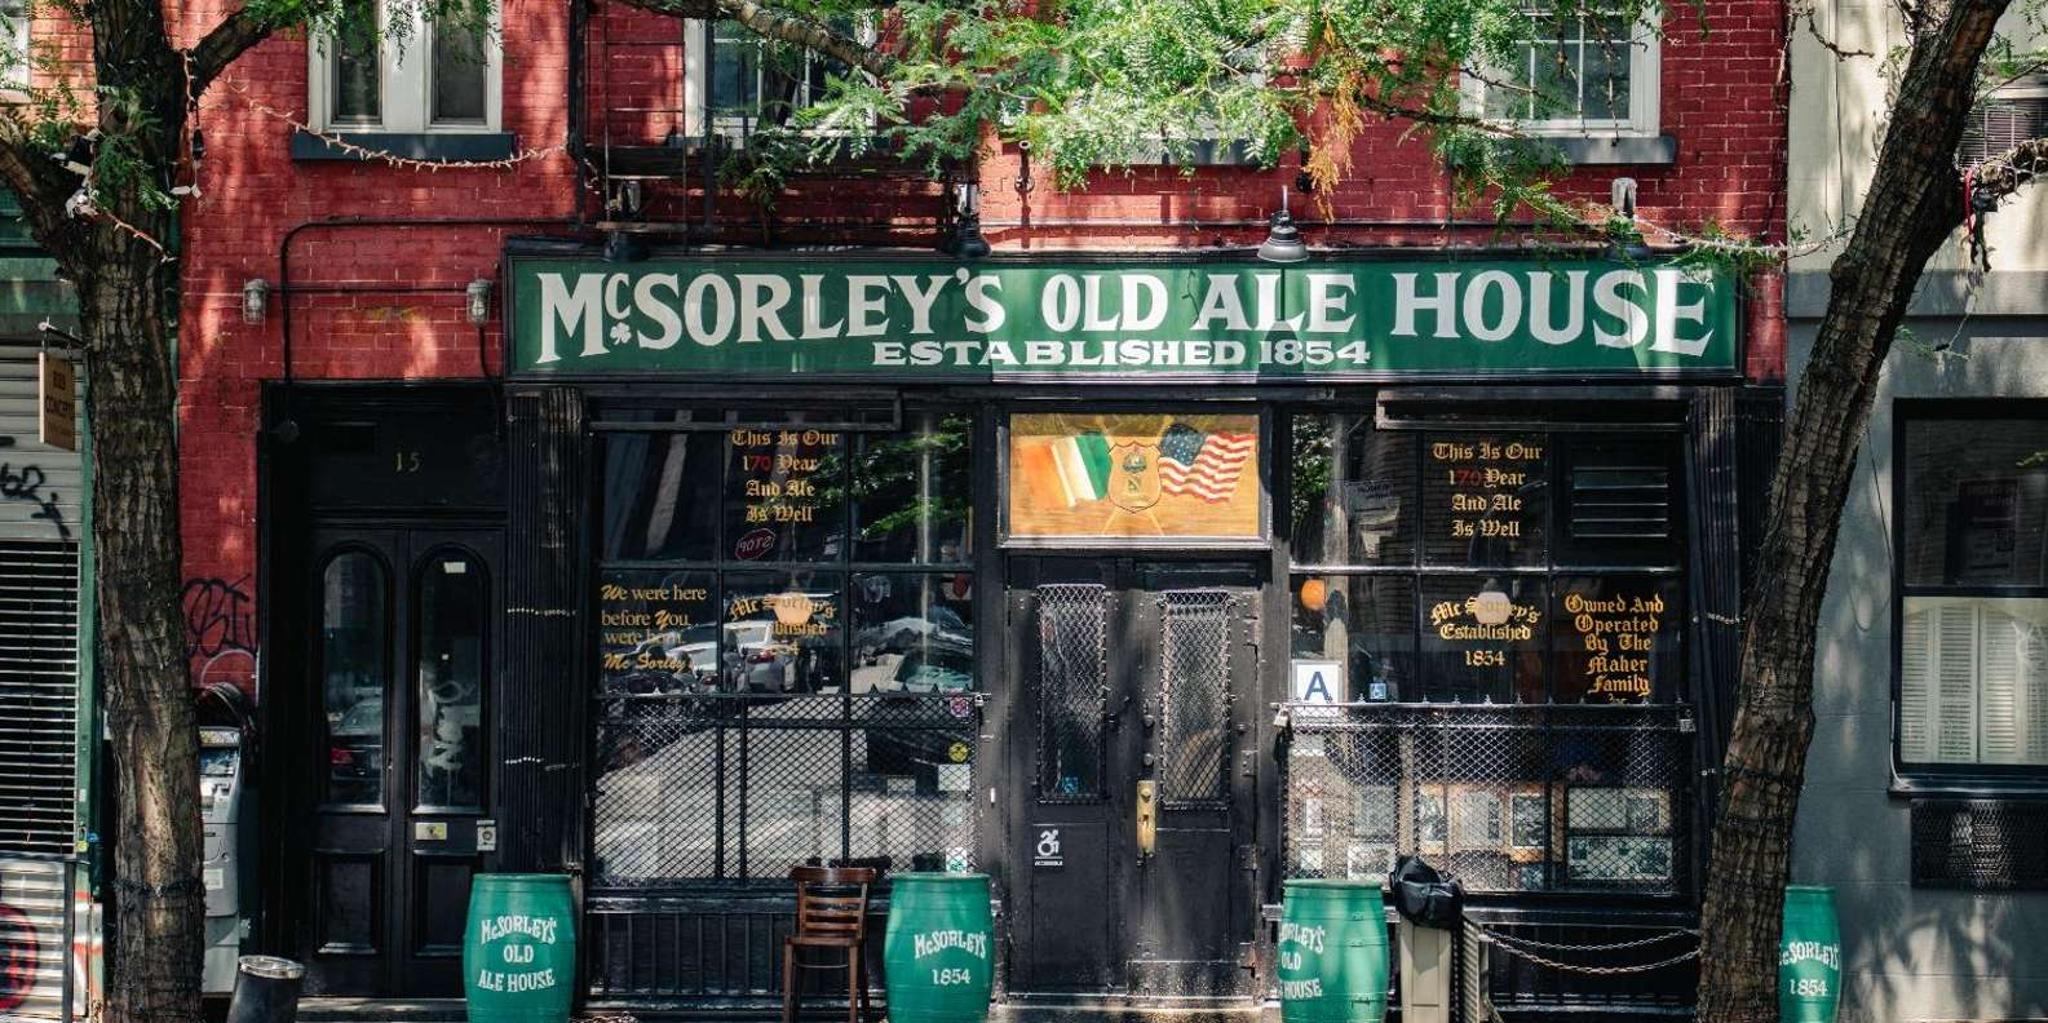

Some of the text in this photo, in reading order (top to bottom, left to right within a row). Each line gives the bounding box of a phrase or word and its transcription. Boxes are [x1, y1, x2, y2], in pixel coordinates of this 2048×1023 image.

[1042, 274, 1168, 332] OLD
[1191, 274, 1357, 332] ALE
[1392, 269, 1714, 355] HOUSE
[873, 341, 1371, 365] ESTABLISHED 1854
[731, 429, 838, 448] This Is Our
[1432, 442, 1543, 461] This Is Our
[395, 451, 421, 473] 15
[743, 454, 818, 474] 170 Year
[745, 480, 816, 496] And Ale
[1448, 468, 1526, 488] 170 Year
[1451, 494, 1521, 511] And Ale
[745, 504, 813, 522] Is Well
[1451, 519, 1520, 536] Is Well
[601, 584, 707, 600] We were here
[1565, 593, 1664, 613] Owned And
[601, 609, 689, 630] before You
[1430, 602, 1460, 625] Mc
[1440, 623, 1531, 642] Established
[1575, 614, 1658, 635] Operated
[605, 632, 641, 644] were
[1585, 633, 1652, 656] By The
[1465, 650, 1506, 666] 1854
[1585, 655, 1648, 674] Maher
[1304, 671, 1330, 700] A
[1587, 674, 1651, 696] Family
[503, 944, 534, 962] OLD
[1281, 951, 1301, 971] OLD
[478, 969, 555, 992] ALE HOUSE
[931, 968, 971, 985] 1854
[1284, 978, 1323, 999] HOUSE
[1790, 979, 1828, 996] 1854
